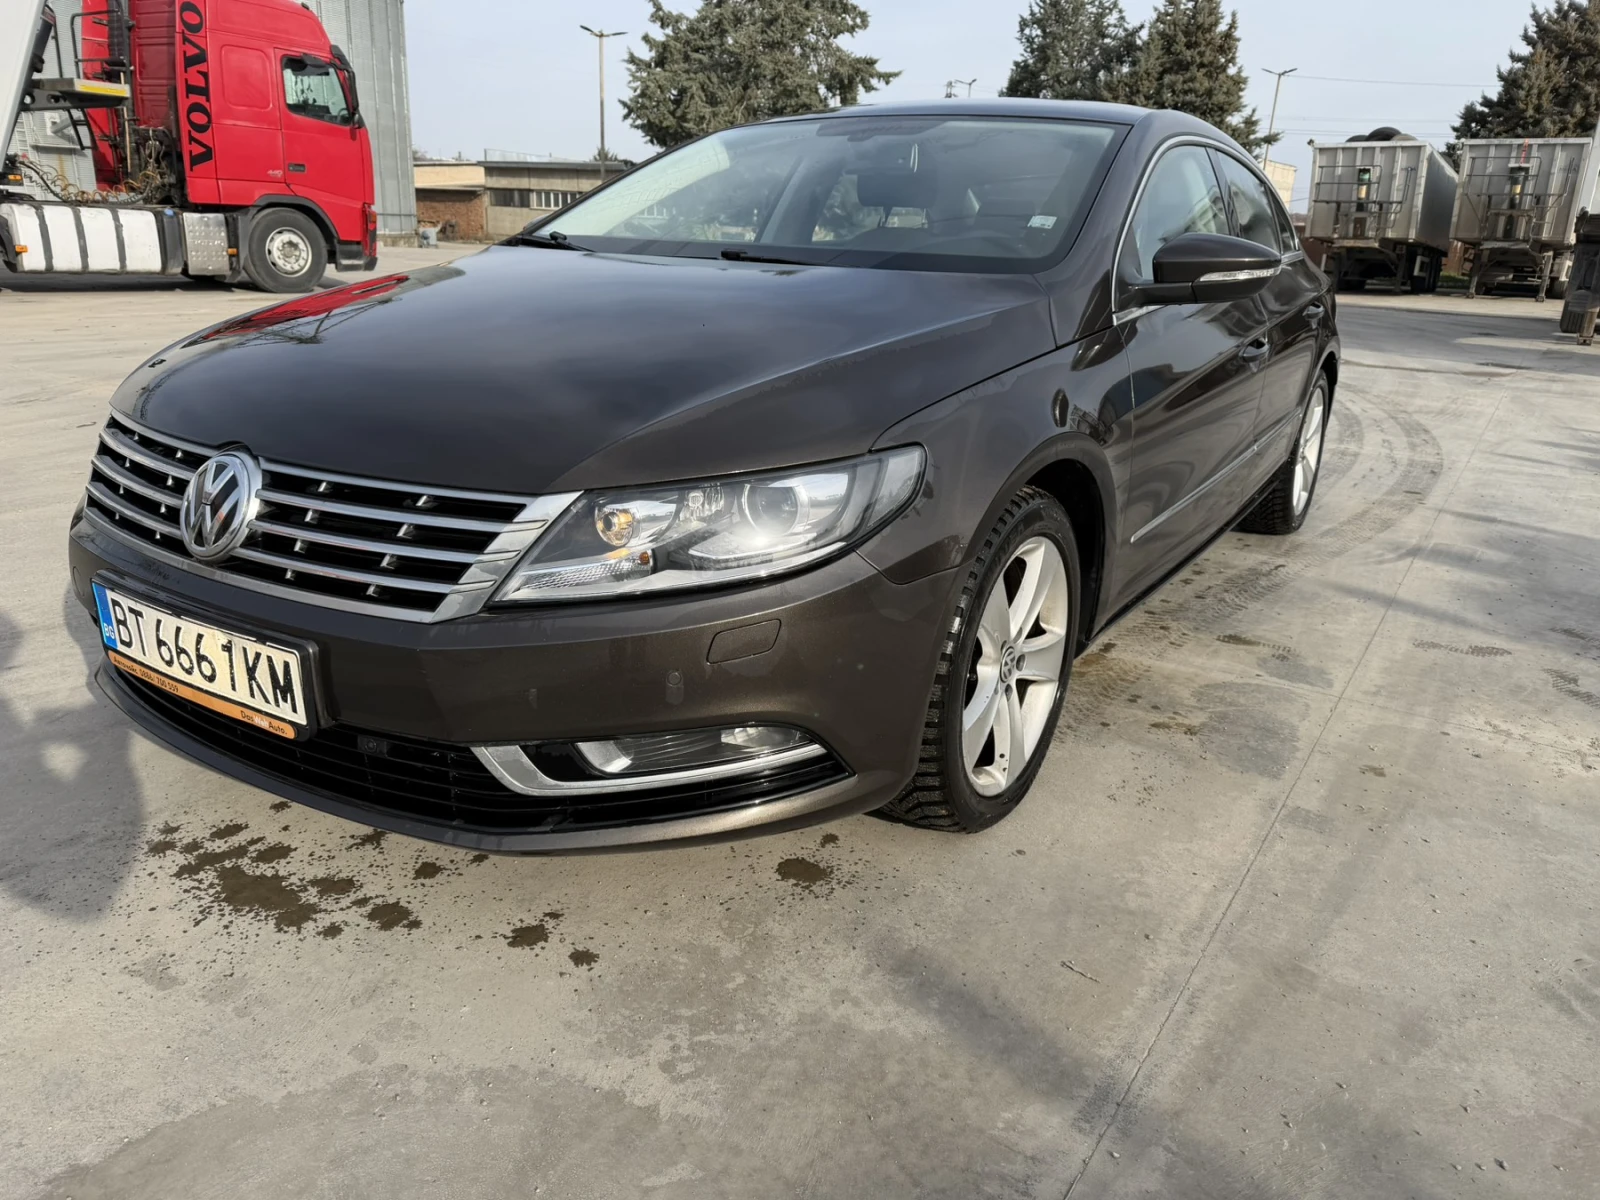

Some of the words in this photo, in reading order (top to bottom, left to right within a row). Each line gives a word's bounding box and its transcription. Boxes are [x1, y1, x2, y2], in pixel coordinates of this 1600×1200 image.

[180, 1, 213, 172] VOLVO
[103, 623, 115, 640] BG
[111, 597, 147, 657] BT
[156, 618, 236, 692] 6661
[242, 646, 298, 715] KM
